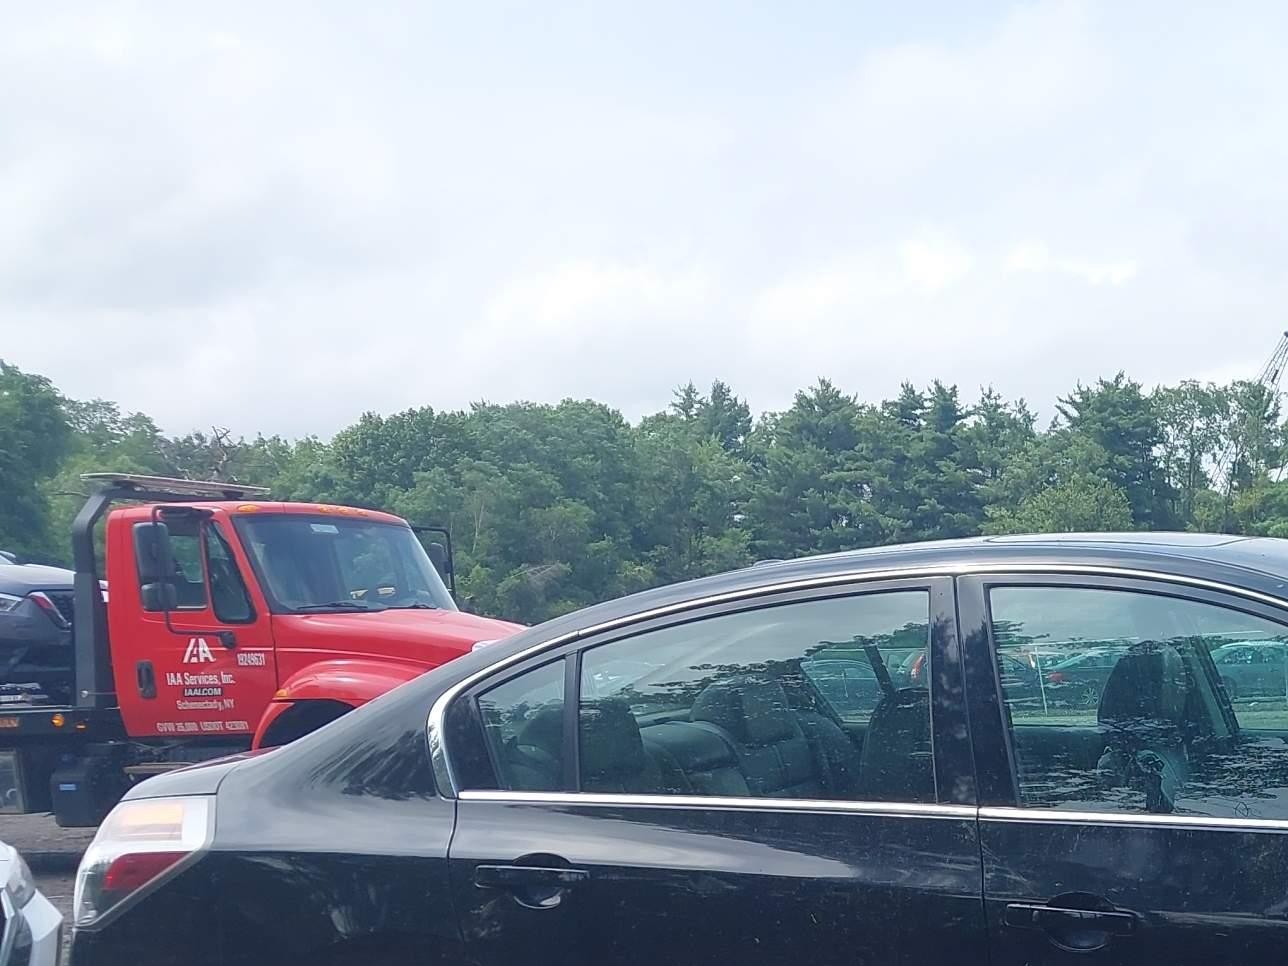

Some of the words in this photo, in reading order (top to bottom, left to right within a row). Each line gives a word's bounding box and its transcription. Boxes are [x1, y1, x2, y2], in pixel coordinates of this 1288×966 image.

[166, 672, 184, 686] IAA
[184, 671, 221, 686] Services,
[221, 671, 236, 684] Inc.
